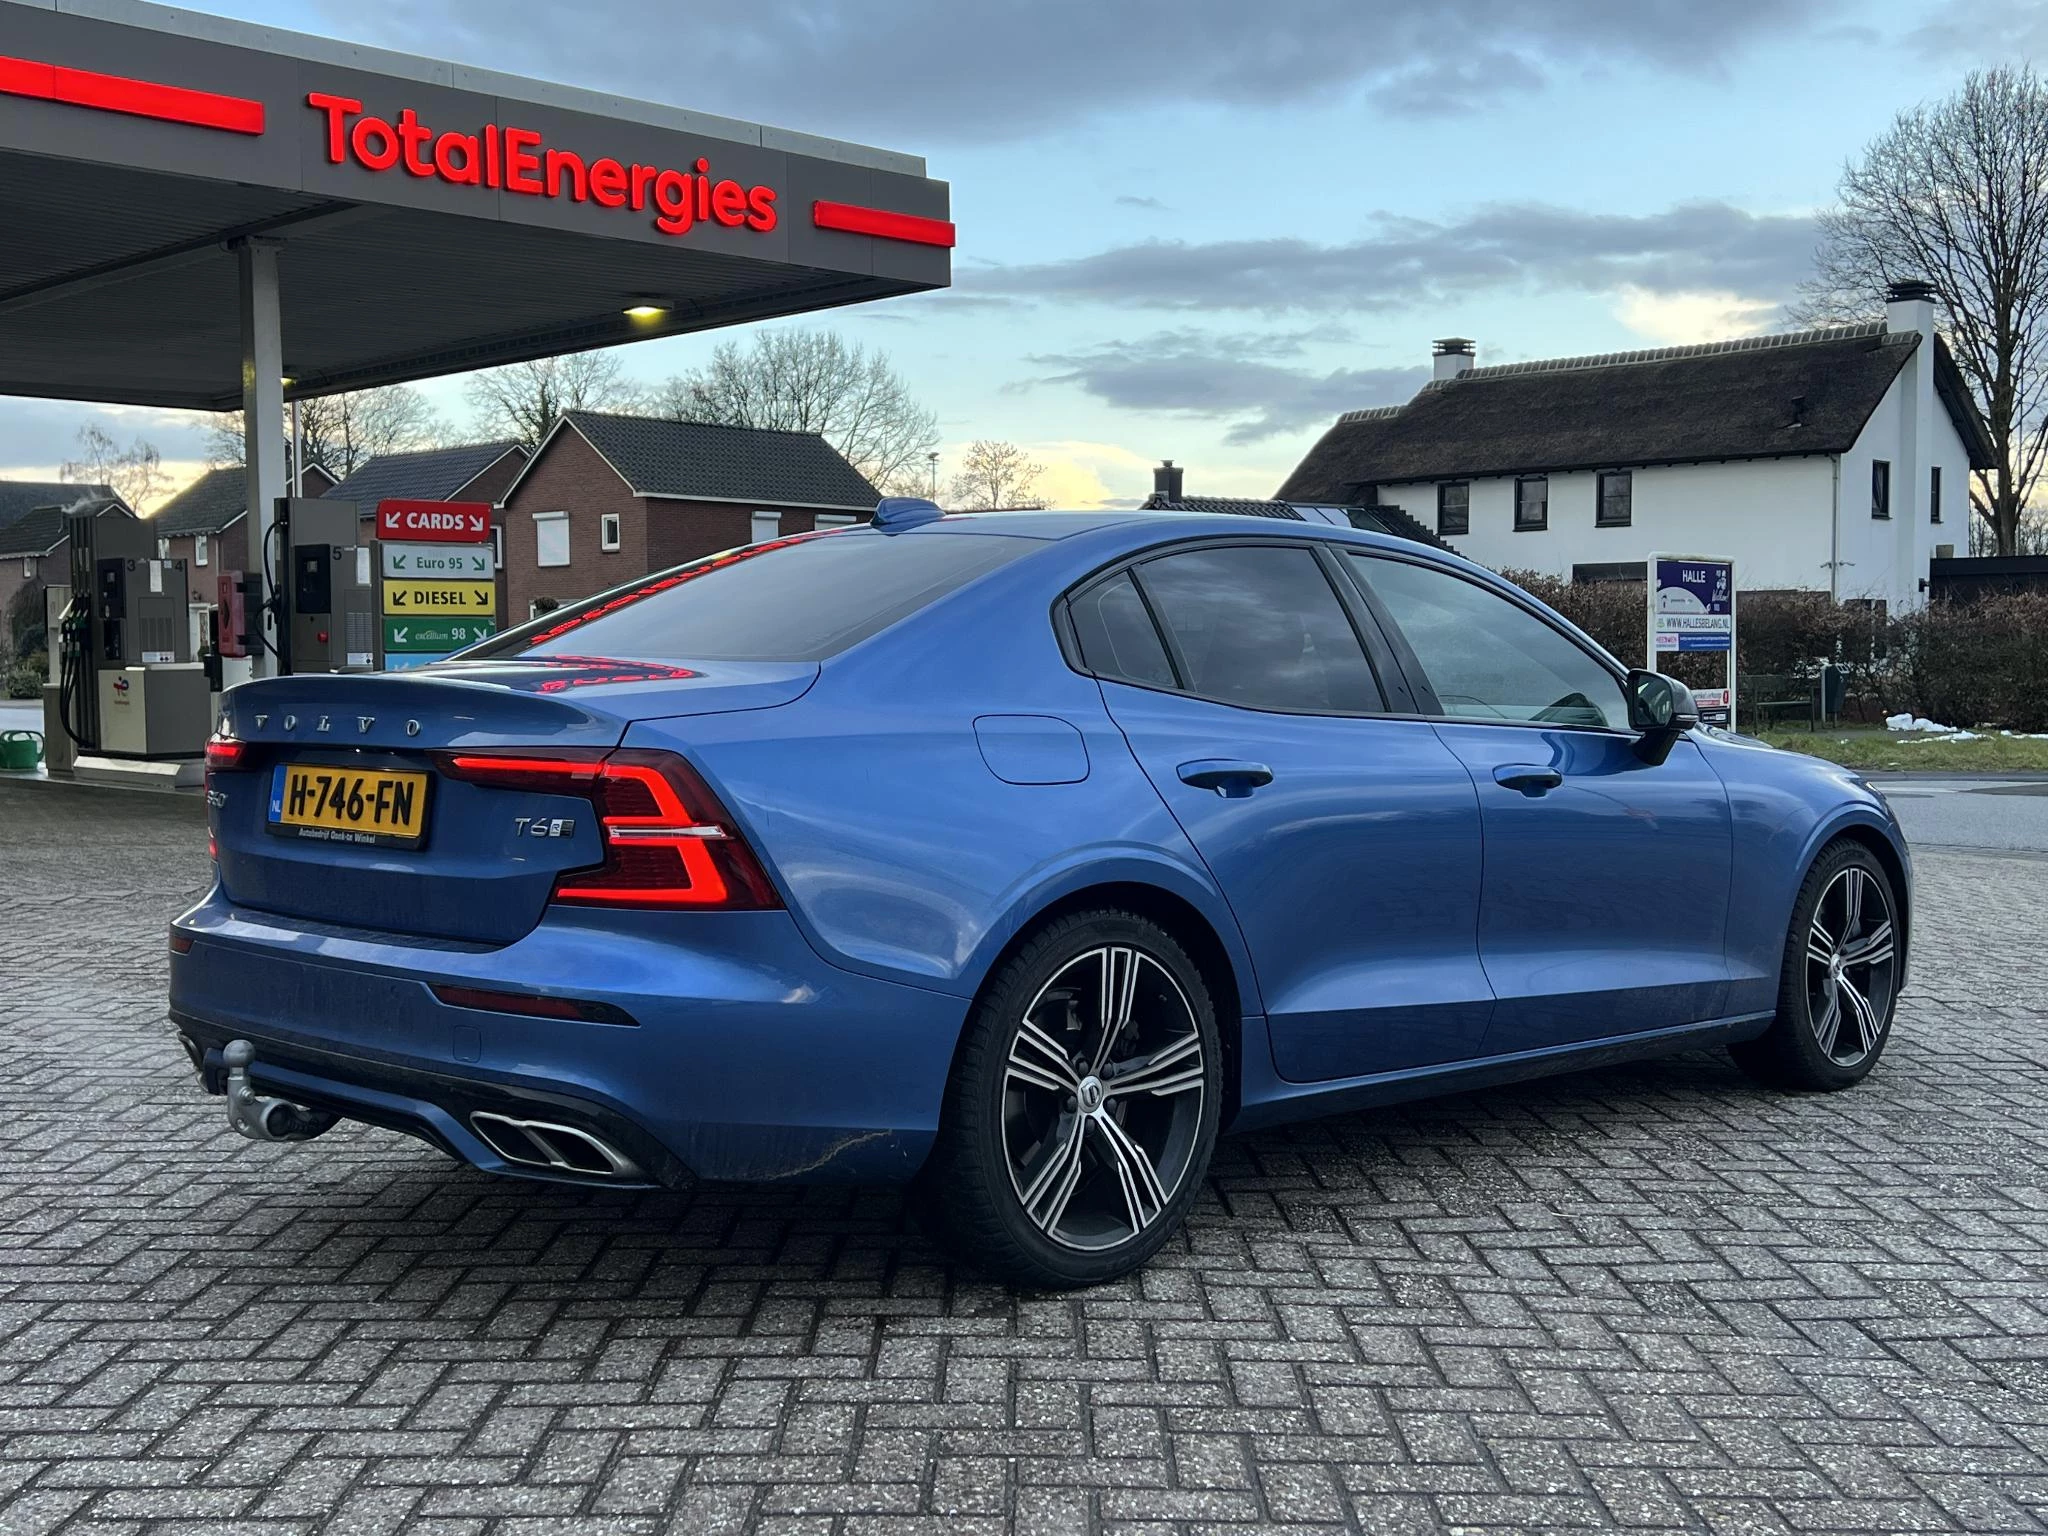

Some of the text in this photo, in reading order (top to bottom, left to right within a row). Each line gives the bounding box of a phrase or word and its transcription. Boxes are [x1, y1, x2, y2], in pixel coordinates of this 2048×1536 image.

[307, 92, 778, 235] TotalEnergies
[406, 512, 465, 530] CARDS
[332, 546, 343, 560] 5
[127, 559, 136, 572] 3
[175, 560, 184, 572] 4
[416, 557, 463, 570] Euro 95
[1682, 570, 1706, 583] HALLE
[414, 591, 467, 605] DIESEL
[451, 627, 467, 640] 98
[255, 715, 421, 737] VOLVO
[288, 773, 415, 826] H-746-FN
[271, 800, 281, 813] NL
[515, 817, 548, 837] T6
[354, 833, 376, 843] Winkel
